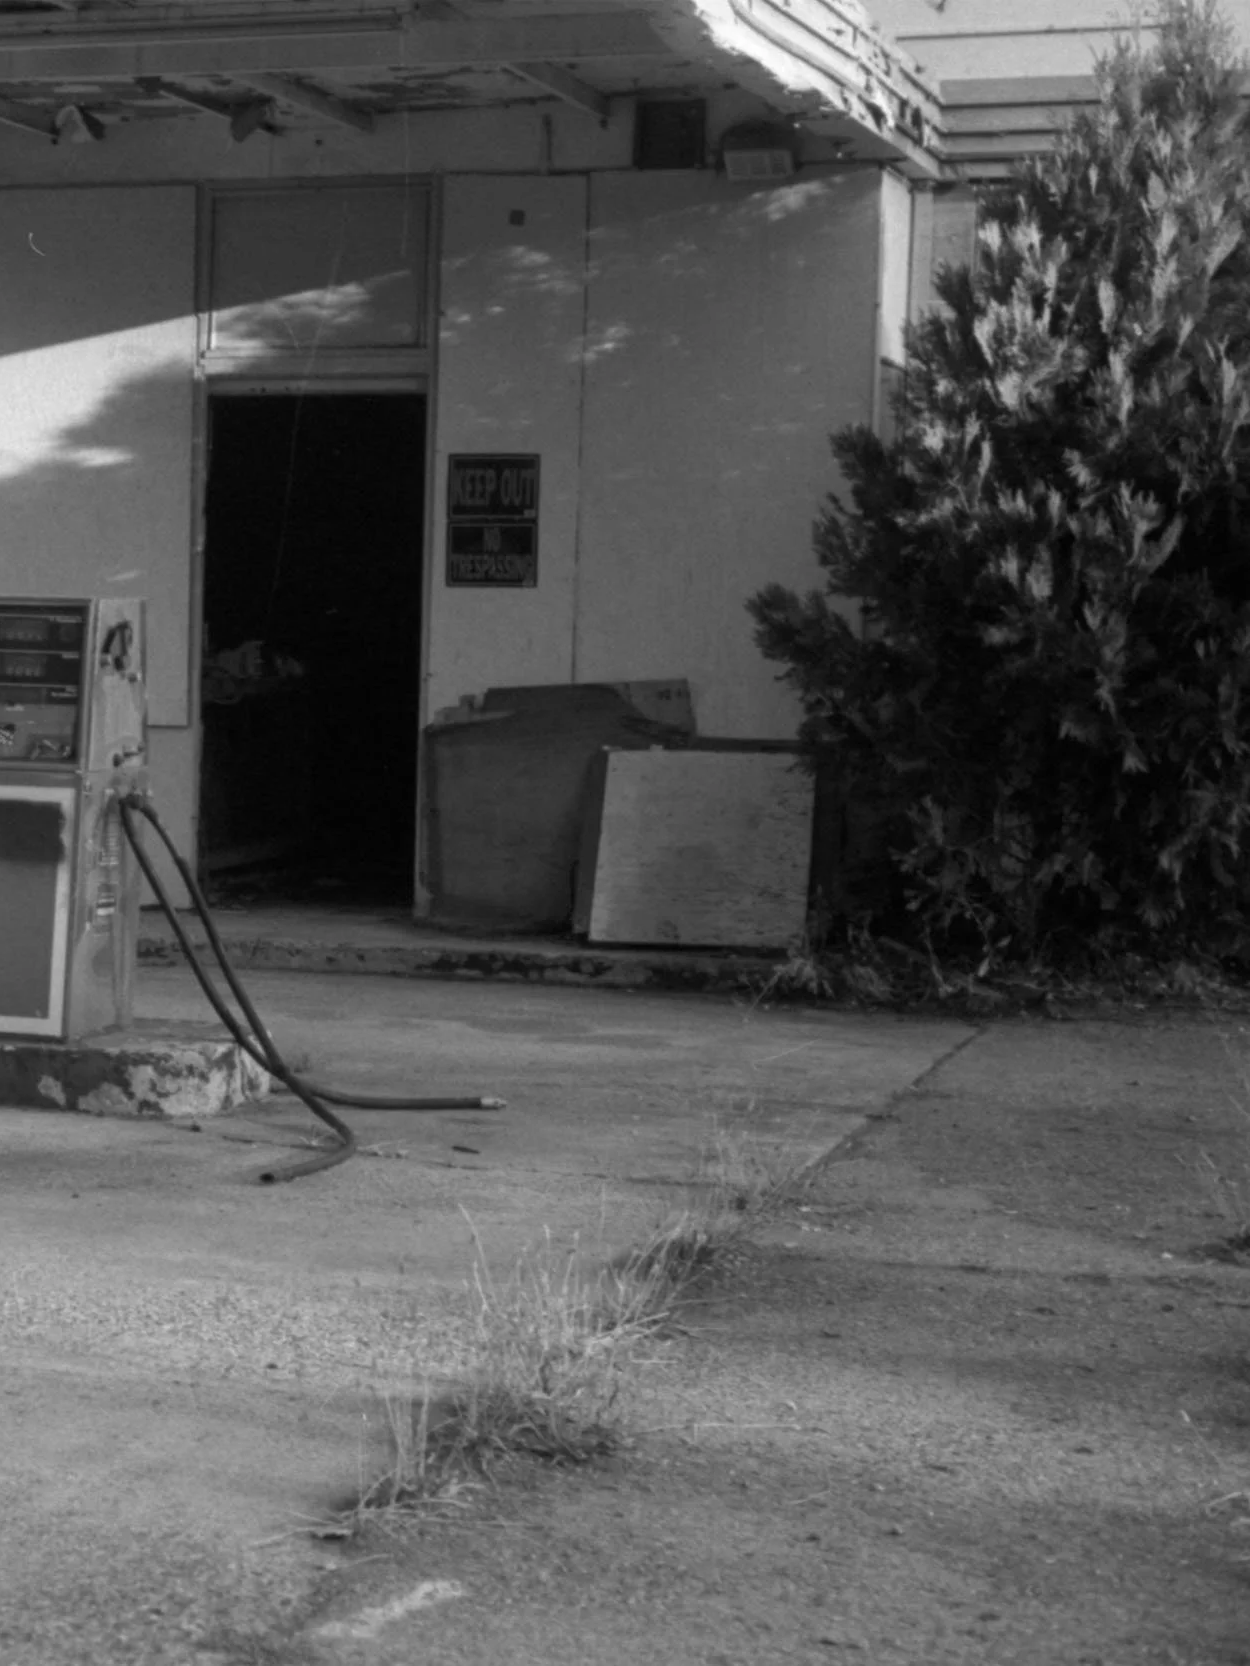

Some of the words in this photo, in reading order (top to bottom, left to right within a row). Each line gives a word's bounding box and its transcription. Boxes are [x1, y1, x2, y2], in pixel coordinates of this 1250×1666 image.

[451, 468, 496, 507] KEEP
[500, 468, 537, 507] OUT
[483, 527, 502, 553] NO
[450, 554, 535, 580] TRESPASSING
